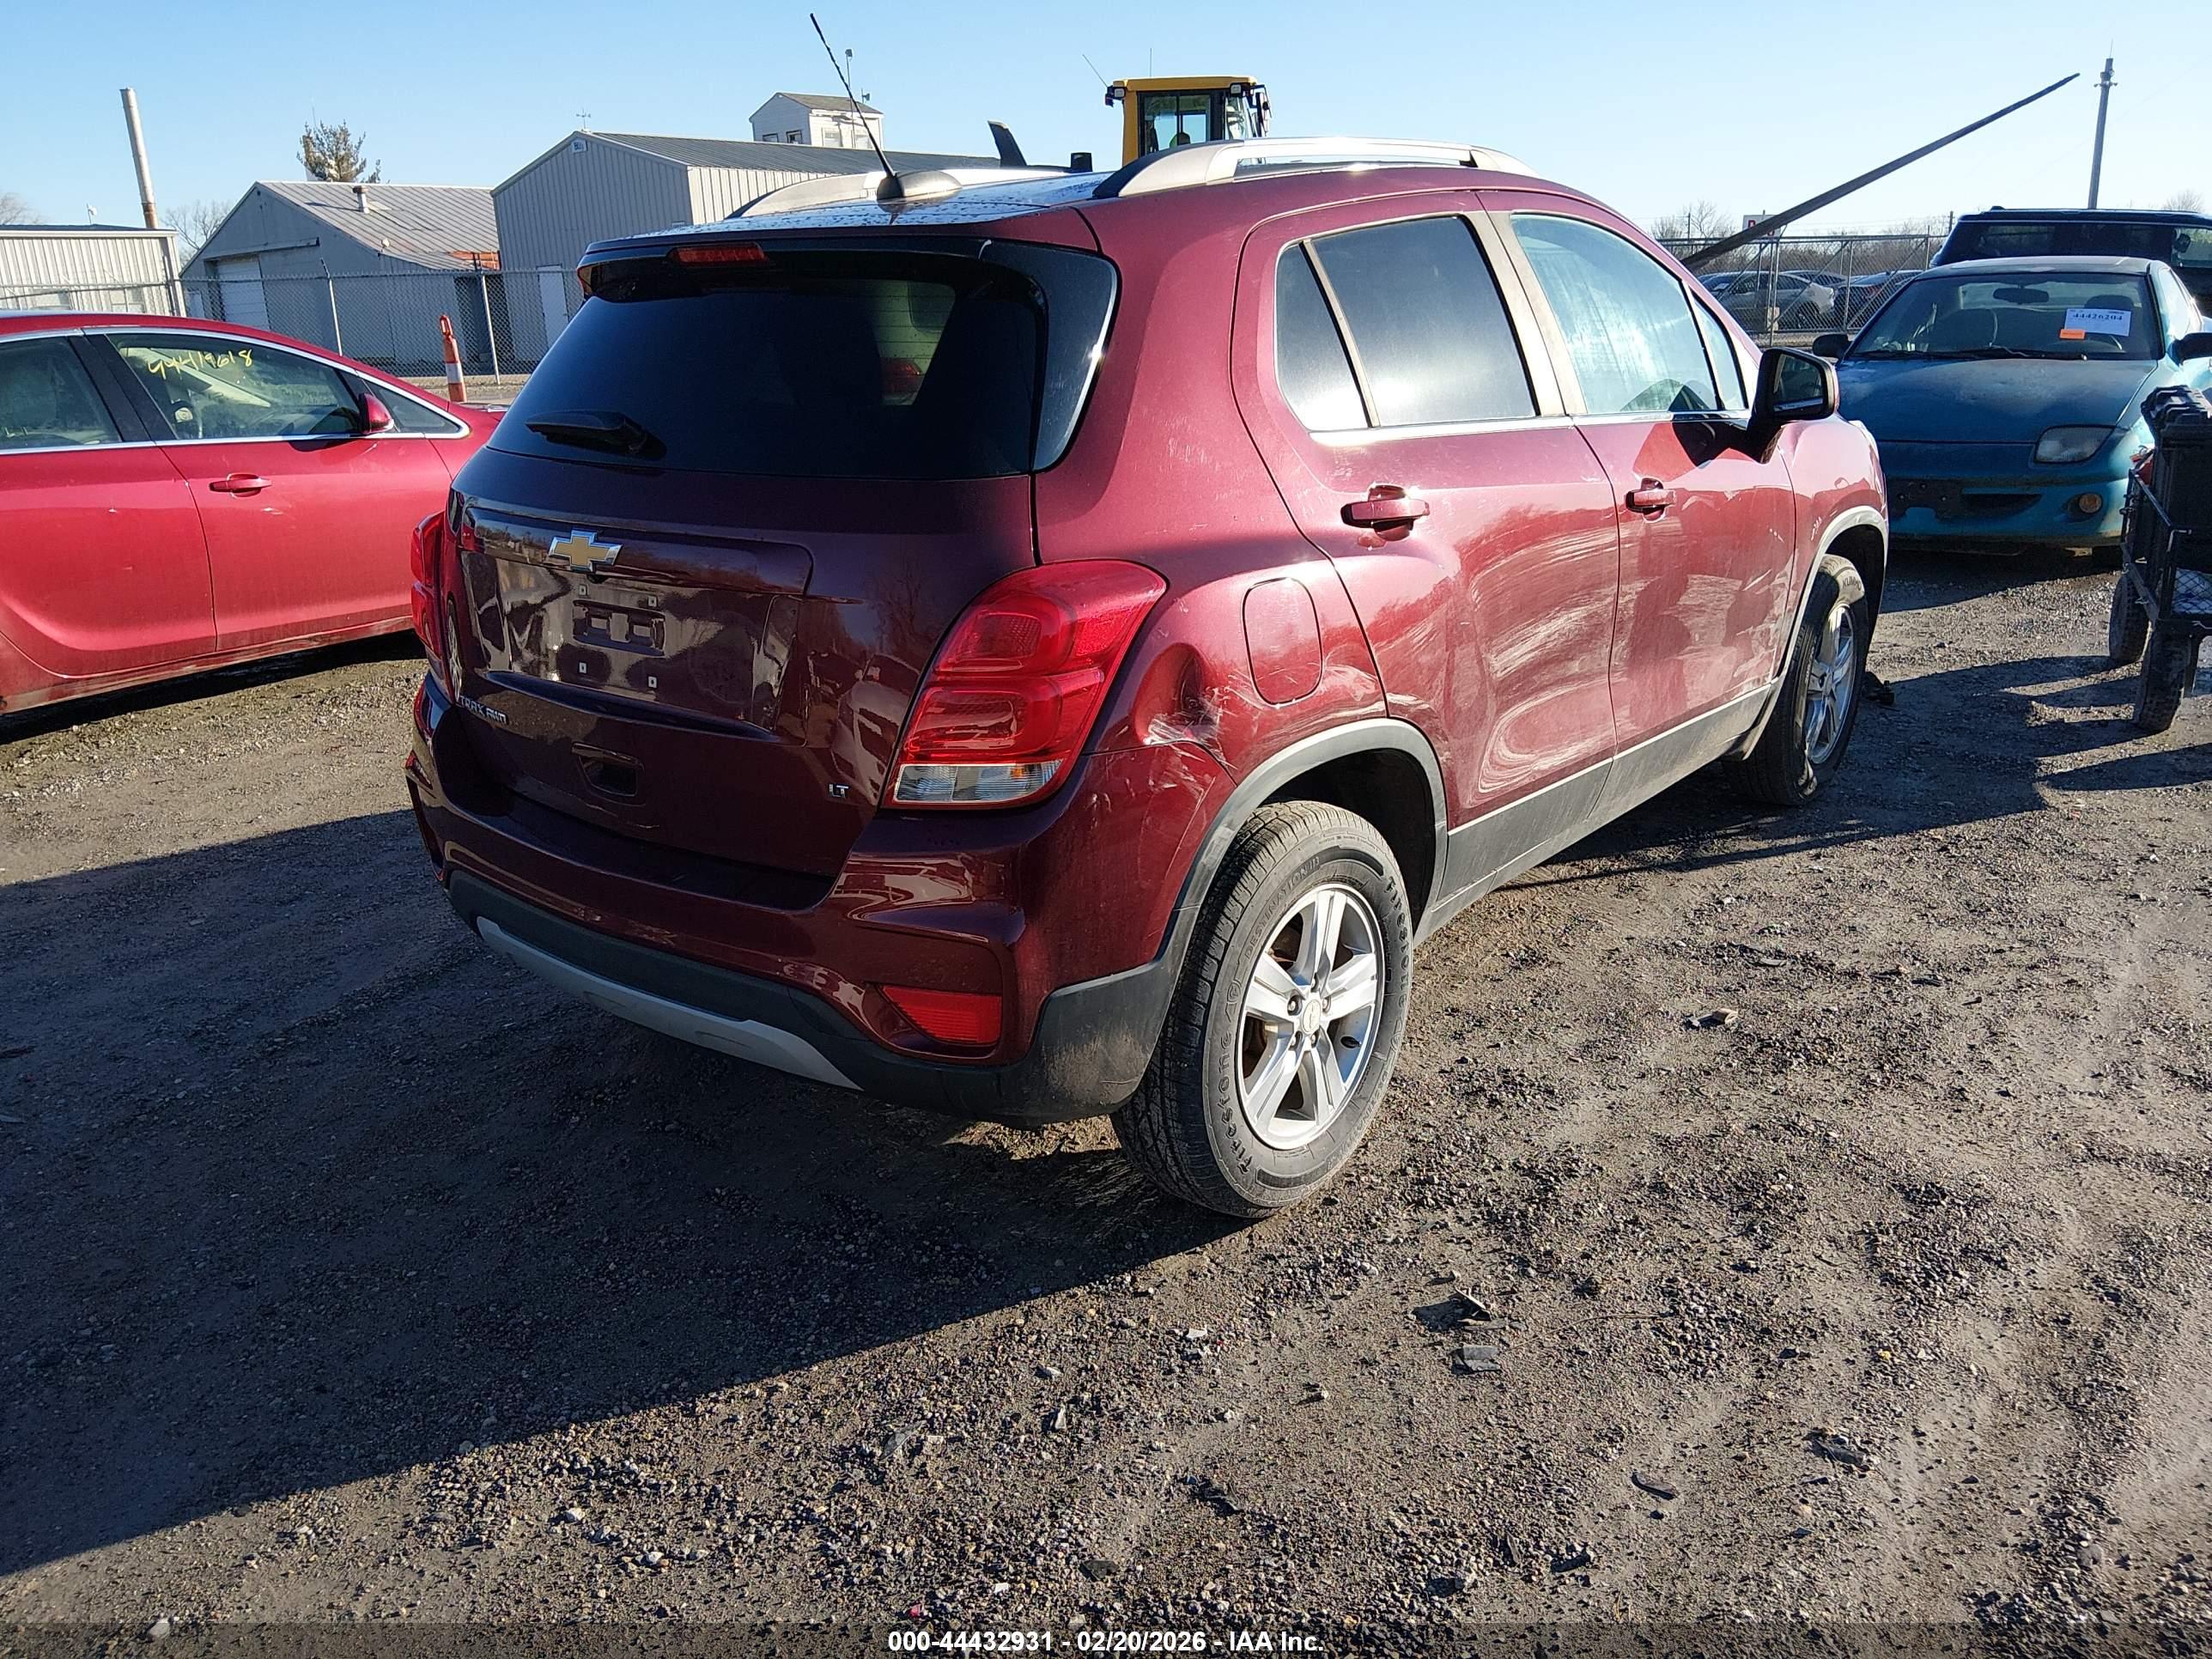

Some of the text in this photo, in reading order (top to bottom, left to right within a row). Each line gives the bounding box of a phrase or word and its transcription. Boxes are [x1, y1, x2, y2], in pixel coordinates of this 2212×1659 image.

[459, 695, 507, 724] TRAX AWD
[829, 783, 849, 798] LT
[1217, 1031, 1254, 1175] Firestone
